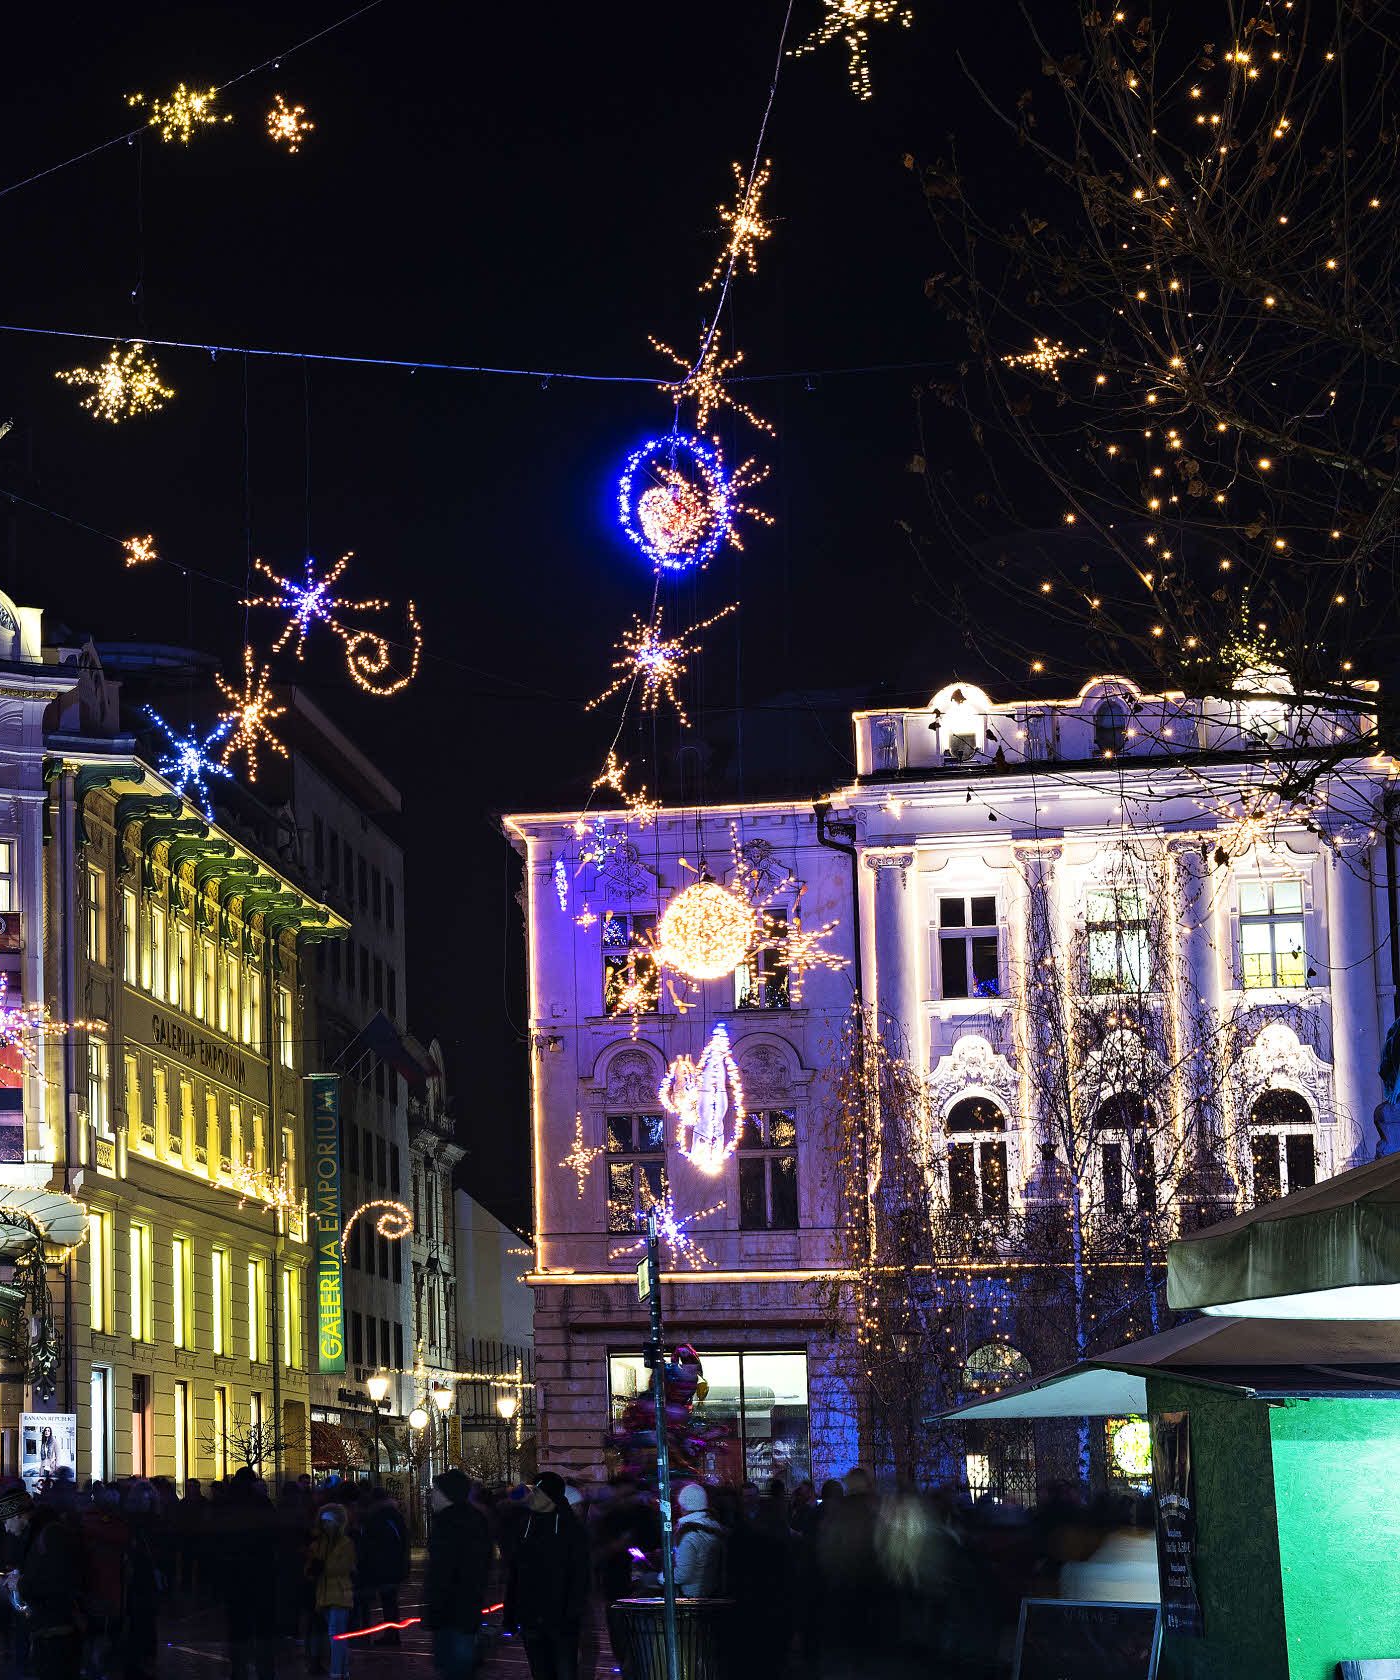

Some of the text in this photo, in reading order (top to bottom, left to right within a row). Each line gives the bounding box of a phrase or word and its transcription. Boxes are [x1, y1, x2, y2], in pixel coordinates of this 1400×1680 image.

[152, 1014, 245, 1085] GALERIJA EMPORIUM
[316, 1089, 342, 1359] GALERIJA EMPORIUM
